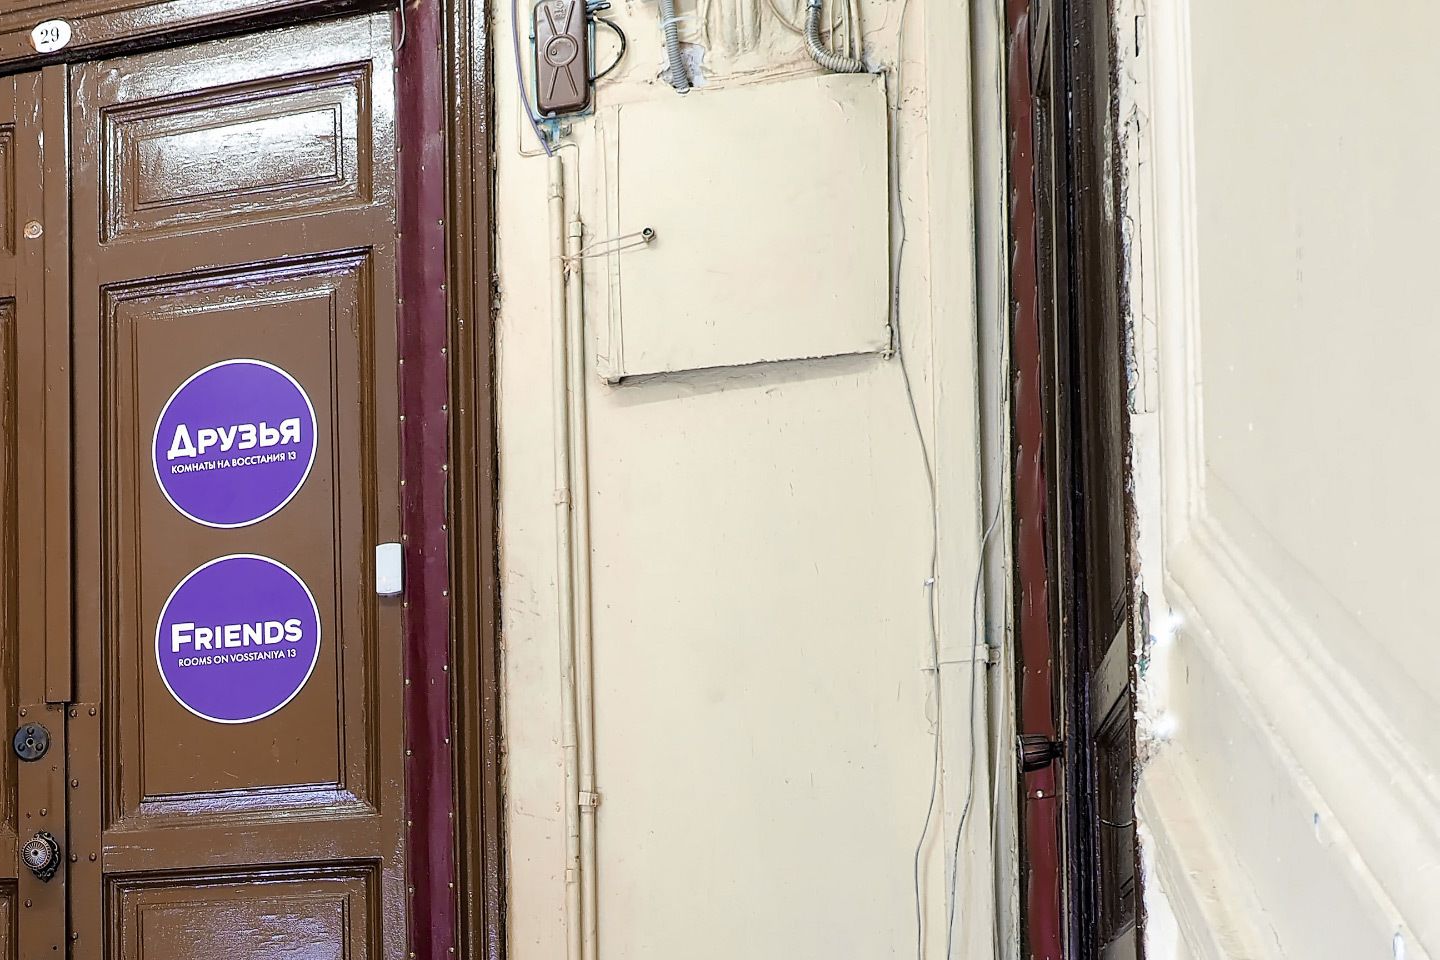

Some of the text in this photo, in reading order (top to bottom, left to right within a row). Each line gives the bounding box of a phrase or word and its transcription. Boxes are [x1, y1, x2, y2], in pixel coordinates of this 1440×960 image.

[40, 26, 60, 45] 29
[171, 451, 296, 474] КОМНАТЫ НА ВОССТАНИЯ 13
[178, 649, 297, 667] ROOMS ON VOSSTANIYA 13
